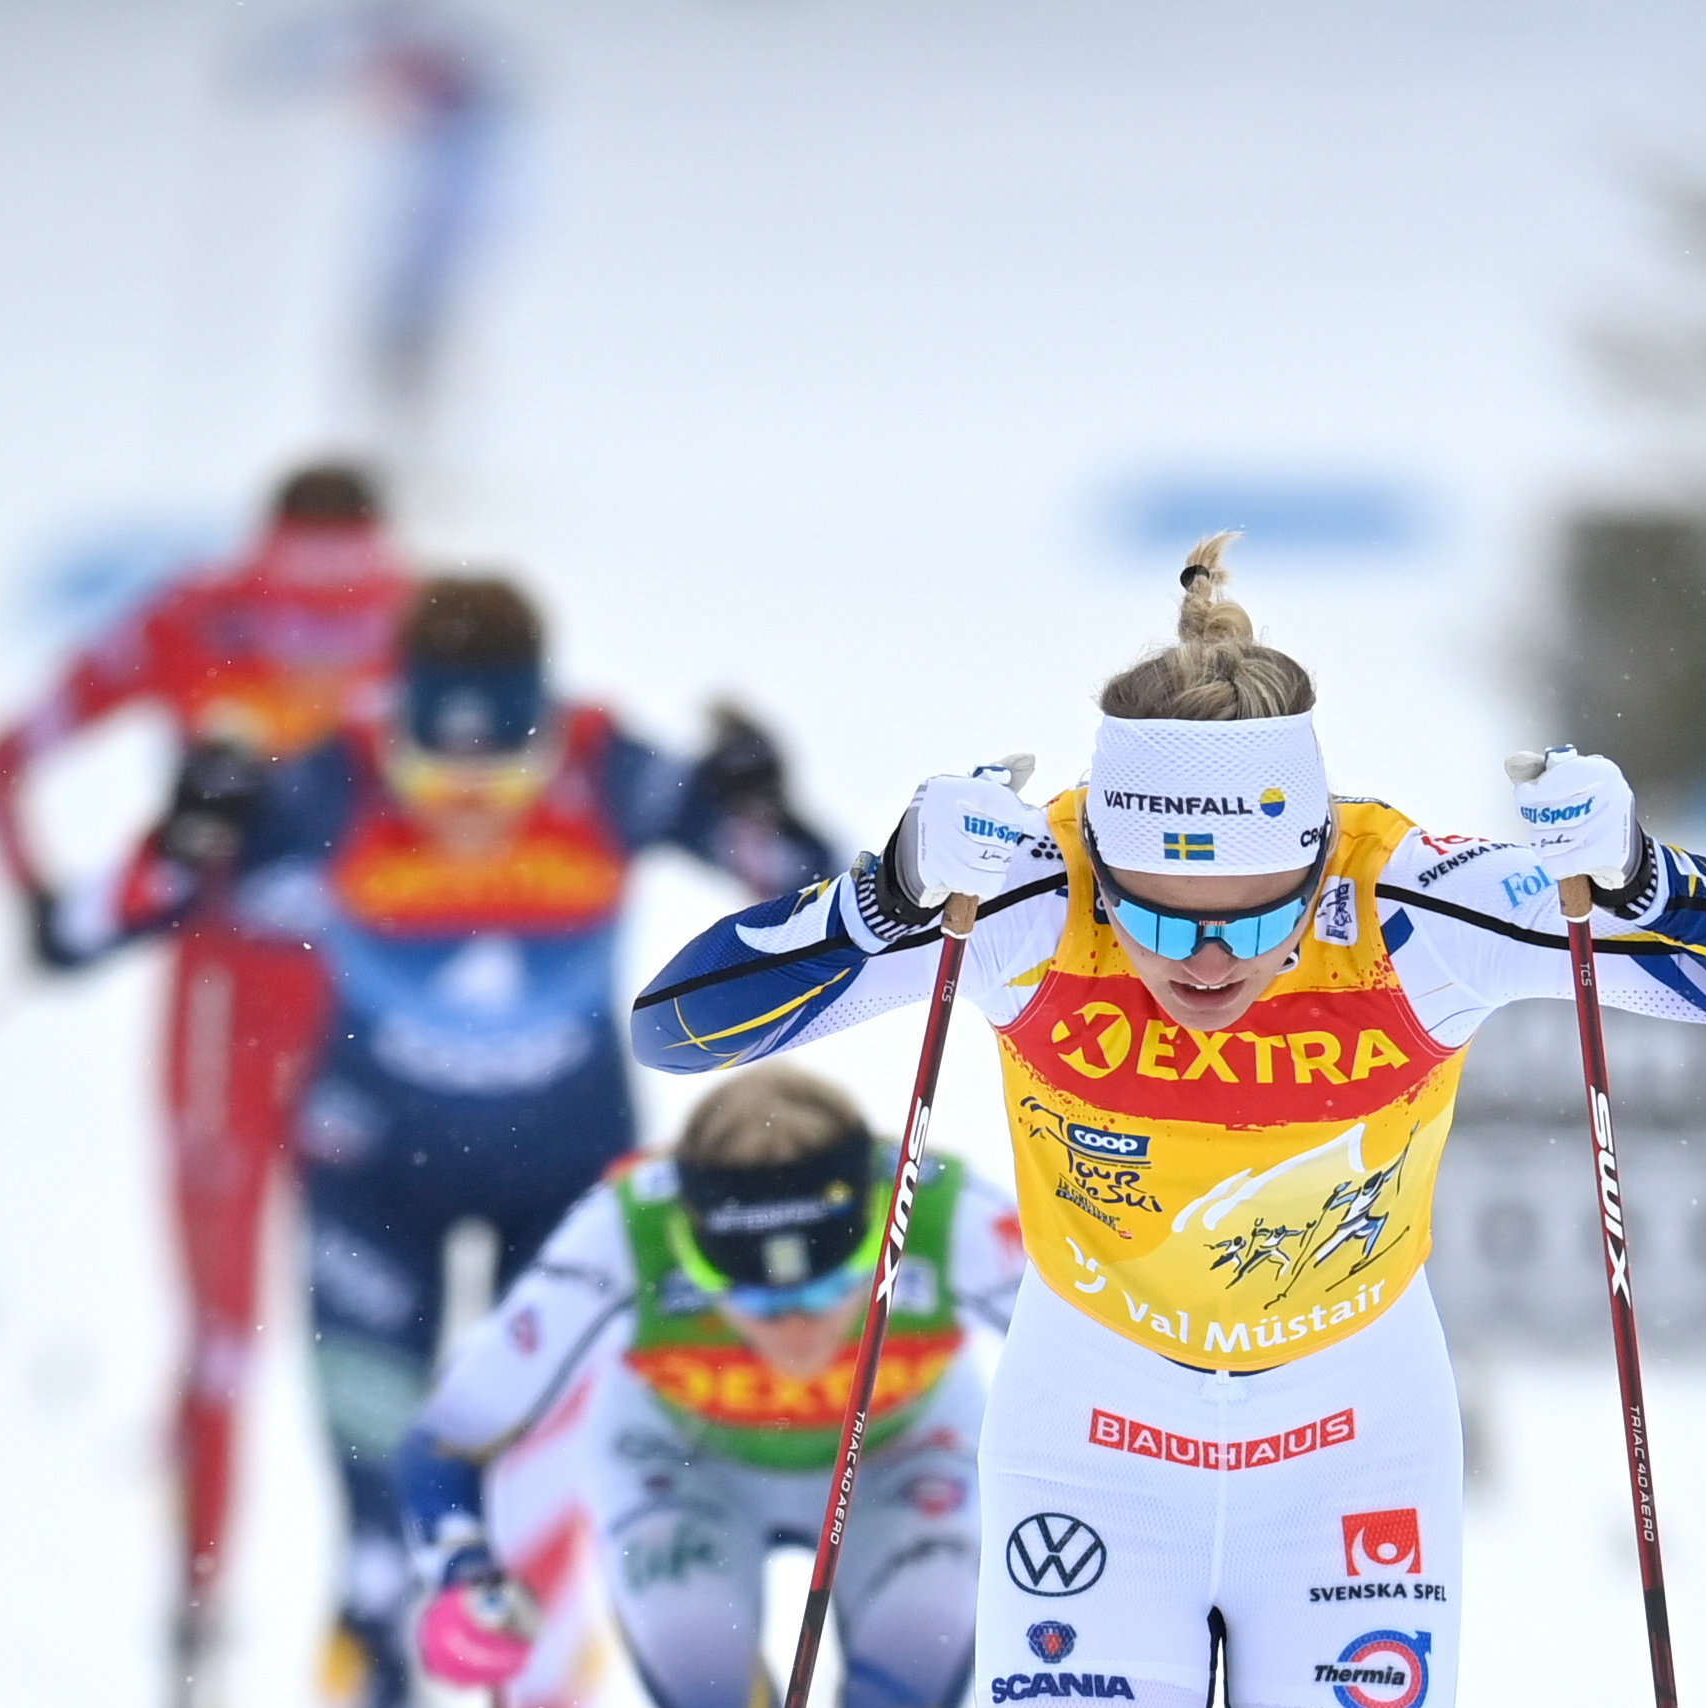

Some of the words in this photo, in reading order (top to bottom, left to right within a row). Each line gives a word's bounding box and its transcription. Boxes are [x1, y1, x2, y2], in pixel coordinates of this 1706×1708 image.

[1104, 789, 1253, 815] VATTENFALL
[1418, 846, 1491, 888] SVENSKA
[1136, 1018, 1411, 1085] EXTRA
[1074, 1129, 1138, 1153] coop
[1121, 1289, 1190, 1344] Val
[1203, 1278, 1388, 1355] Müstair
[846, 1411, 866, 1466] TRIAC
[1093, 1410, 1353, 1468] BAUHAUS
[1630, 1405, 1646, 1459] TRIAC
[1639, 1490, 1655, 1542] AERO
[830, 1493, 847, 1545] AERO
[1309, 1583, 1407, 1603] SVENSKA
[1413, 1583, 1447, 1602] SPEL
[992, 1672, 1135, 1704] SCANIA
[1314, 1664, 1406, 1686] Thermia
